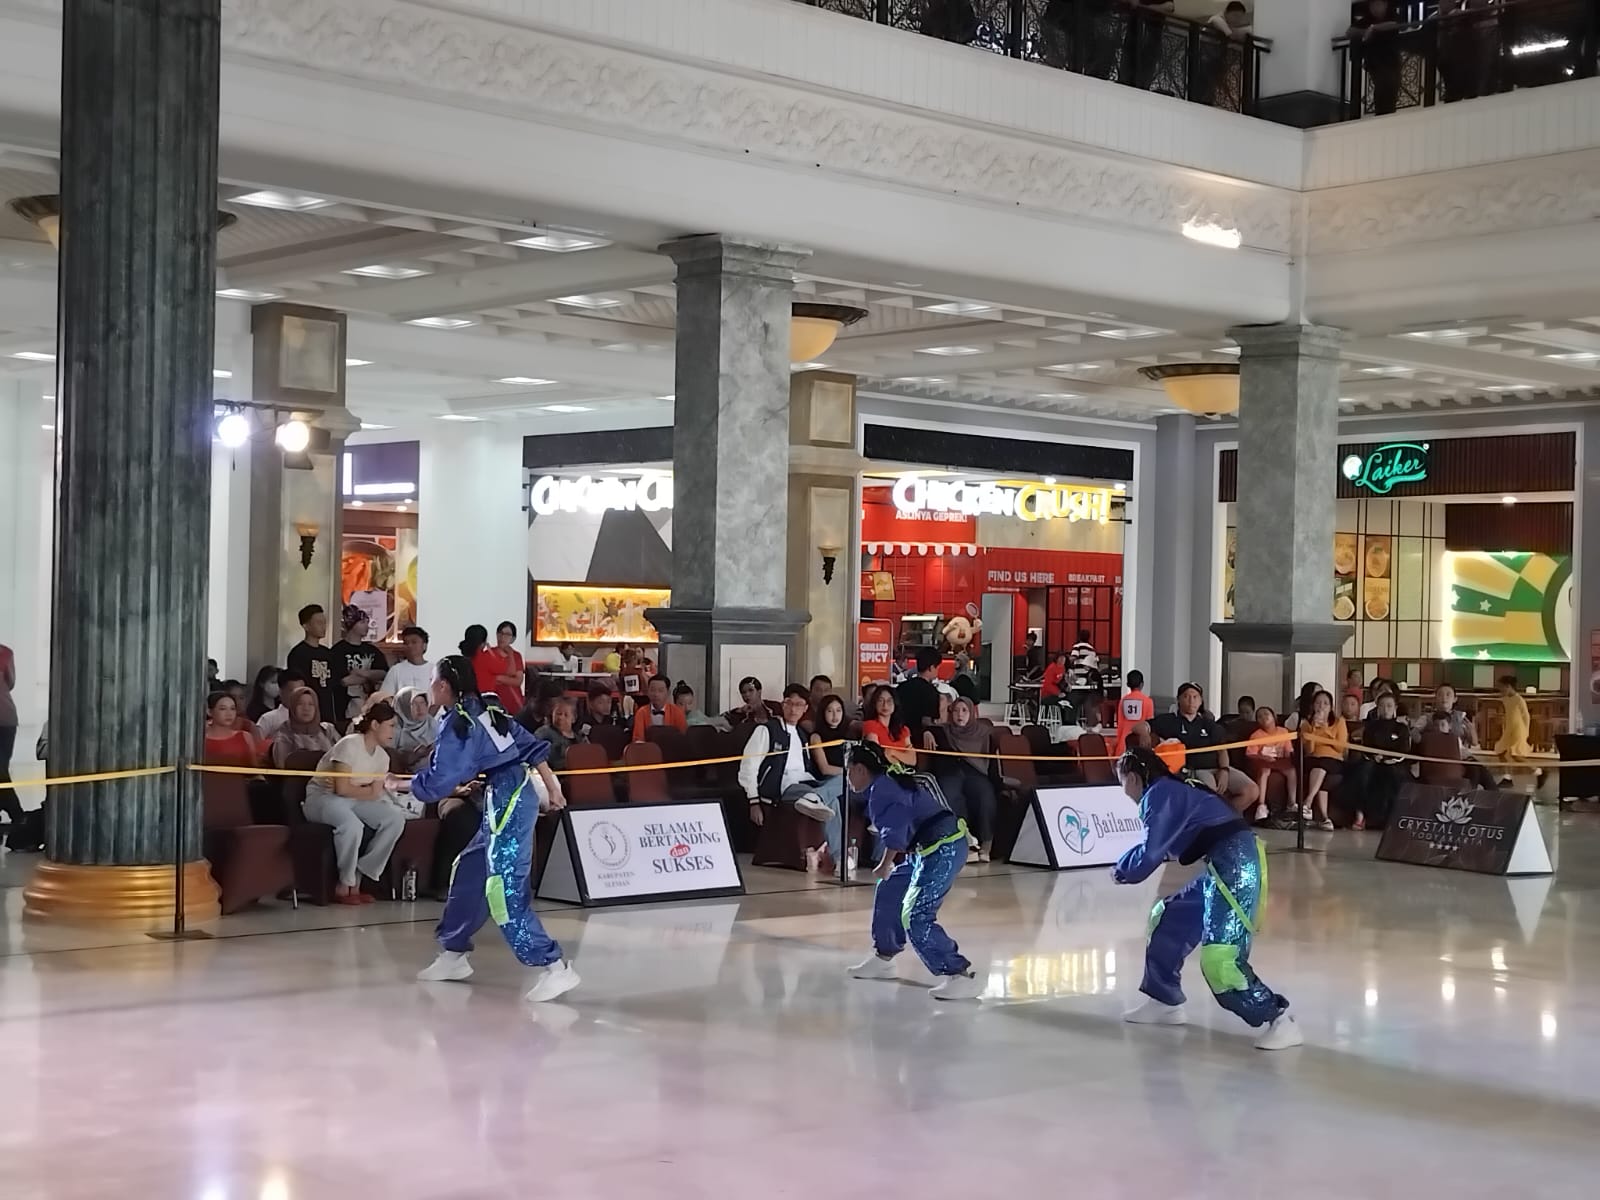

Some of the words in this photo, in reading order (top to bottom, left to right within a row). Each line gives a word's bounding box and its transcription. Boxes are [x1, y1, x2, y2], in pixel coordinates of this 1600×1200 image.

[1355, 449, 1427, 494] Laiker
[988, 570, 1011, 582] FIND
[1014, 571, 1027, 582] US
[1030, 572, 1054, 584] HERE
[860, 652, 888, 663] SPICY
[1127, 704, 1138, 715] 31
[644, 821, 704, 836] SELAMAT
[1398, 818, 1453, 834] CRYSTAL
[1461, 824, 1504, 840] LOTUS
[639, 832, 721, 848] BERTANDING
[671, 845, 690, 858] dan
[652, 855, 714, 874] SUKSES
